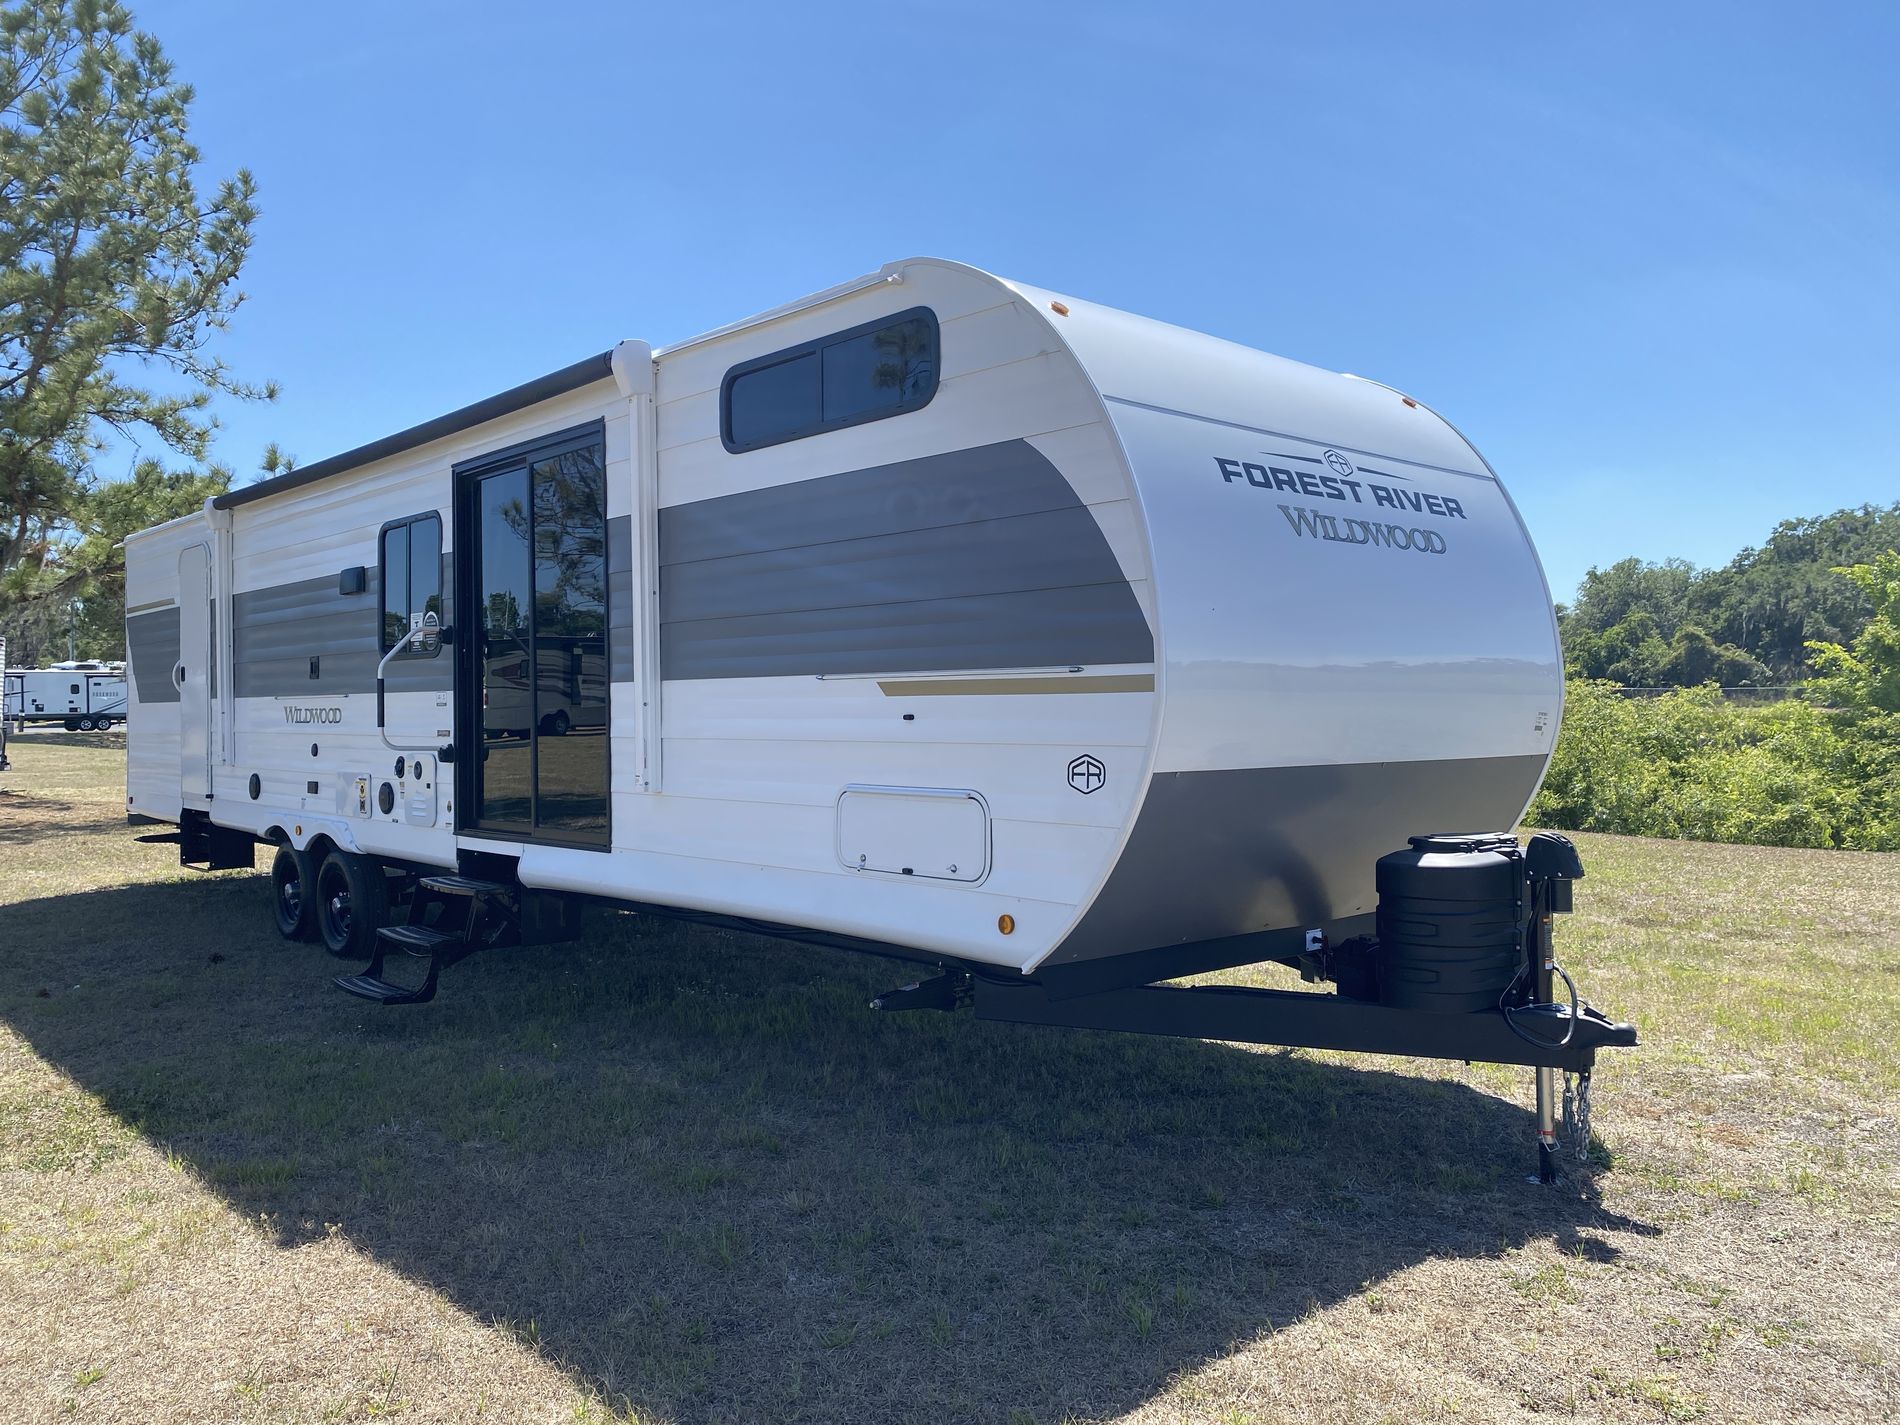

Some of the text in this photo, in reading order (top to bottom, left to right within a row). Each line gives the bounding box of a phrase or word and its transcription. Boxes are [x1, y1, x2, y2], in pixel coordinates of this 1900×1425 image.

[1213, 456, 1467, 520] FOREST RIVER
[1277, 504, 1447, 554] WILDWOOD
[284, 706, 342, 724] WILDWOOD
